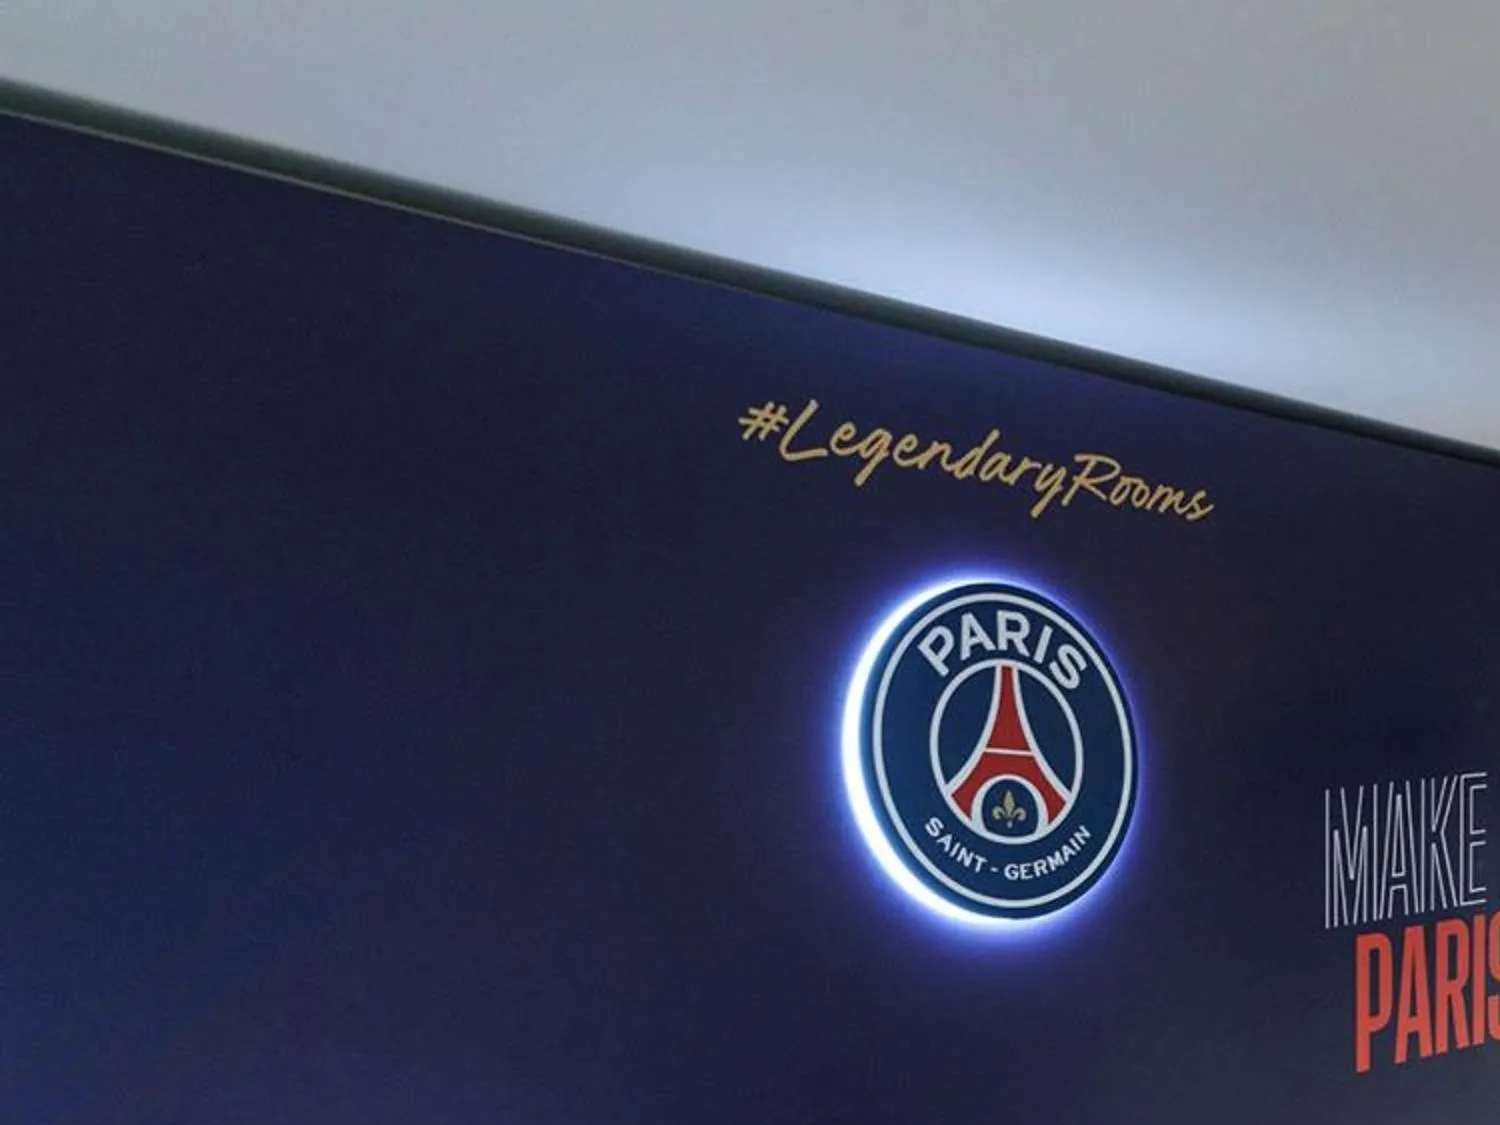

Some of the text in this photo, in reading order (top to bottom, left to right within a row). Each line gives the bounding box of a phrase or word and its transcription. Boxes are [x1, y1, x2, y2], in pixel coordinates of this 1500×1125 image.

[738, 400, 1214, 521] #LegendaryRooms
[918, 609, 1087, 690] PARIS
[924, 816, 988, 874] SAINT
[1004, 825, 1092, 881] GERMAIN
[1324, 771, 1488, 929] MAKE
